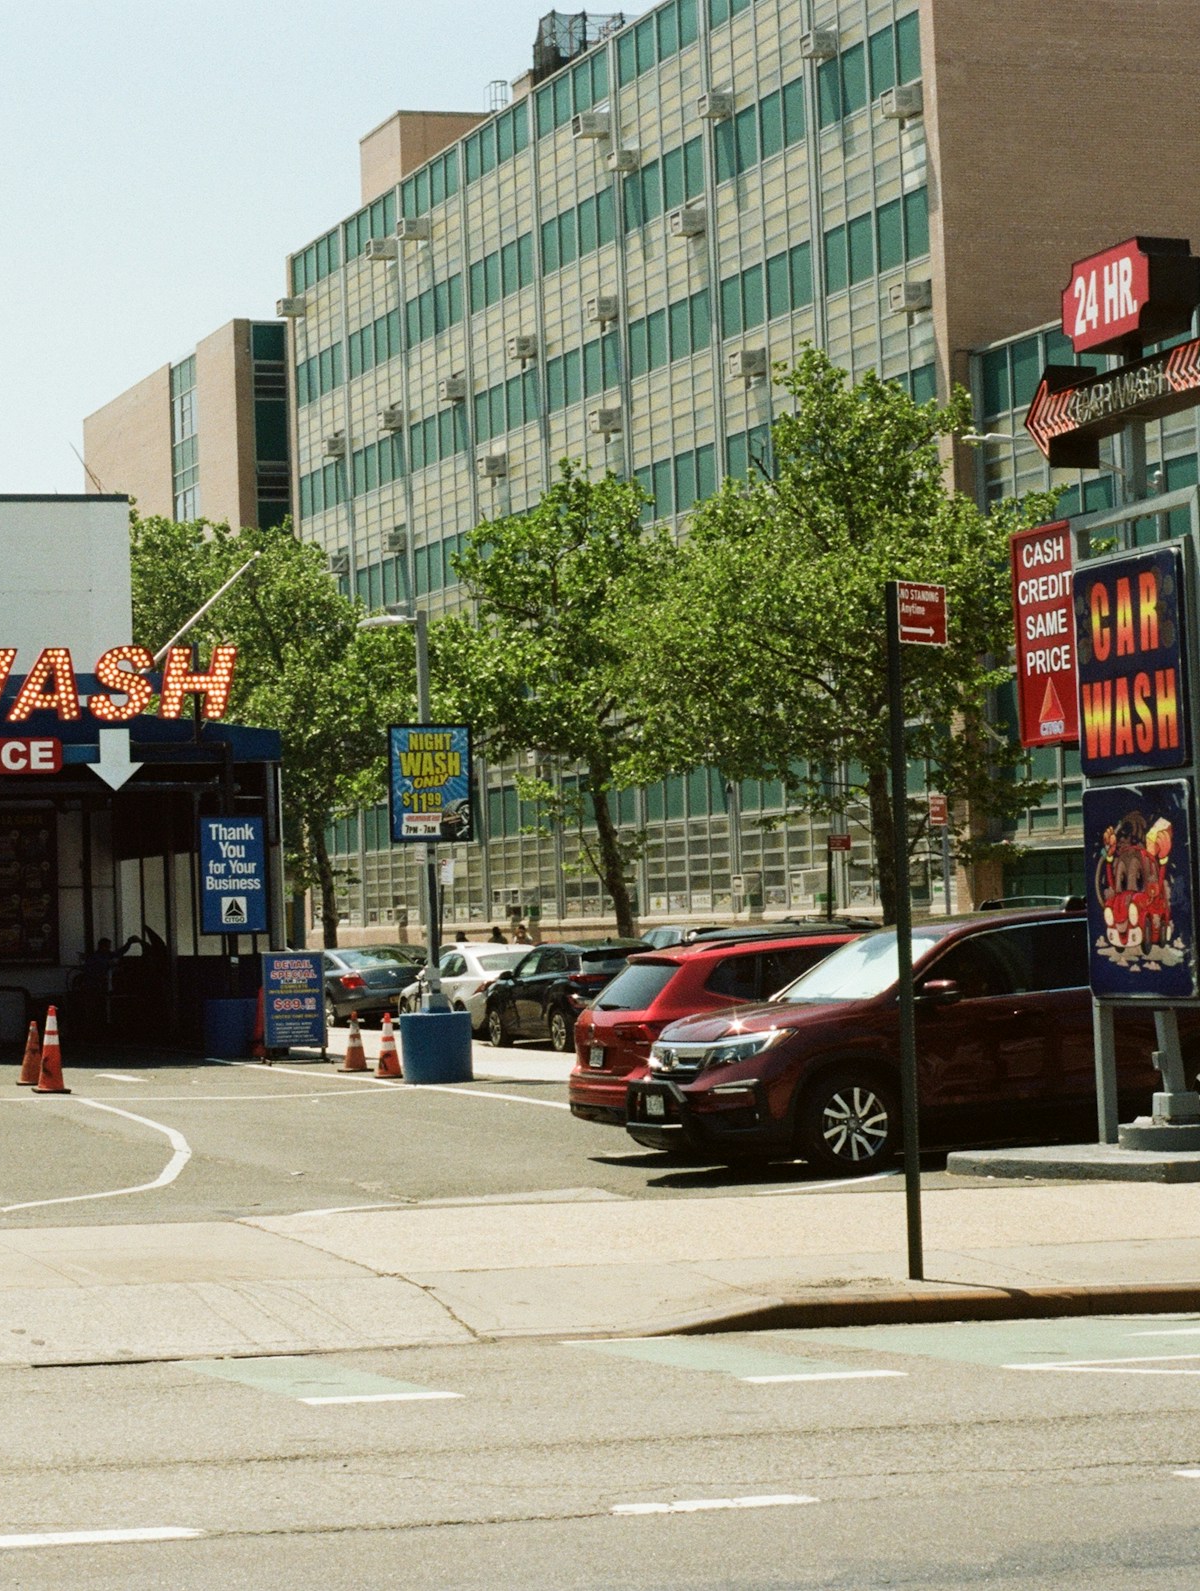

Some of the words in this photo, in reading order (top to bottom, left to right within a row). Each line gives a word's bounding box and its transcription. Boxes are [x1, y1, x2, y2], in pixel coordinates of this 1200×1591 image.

[1074, 269, 1098, 337] 24
[1103, 256, 1138, 325] HR.
[1022, 535, 1064, 569] CASH
[900, 588, 909, 600] NO
[910, 589, 939, 603] STANDING
[1018, 570, 1072, 606] CREDIT
[901, 602, 926, 616] Anytime
[1090, 571, 1159, 662] CAR
[1026, 608, 1068, 641] SAME
[1026, 645, 1071, 677] PRICE
[1082, 667, 1179, 760] WASH
[408, 733, 452, 751] NIGHT
[399, 751, 461, 777] WASH
[413, 773, 449, 790] ONLY
[208, 823, 255, 841] Thank
[405, 825, 418, 833] 7PM
[424, 825, 436, 833] 7AM
[219, 841, 246, 858] You
[208, 860, 226, 874] for
[228, 860, 257, 874] Your
[205, 875, 261, 890] Business
[274, 960, 313, 970] DETAIL
[270, 969, 317, 980] SPECIAL
